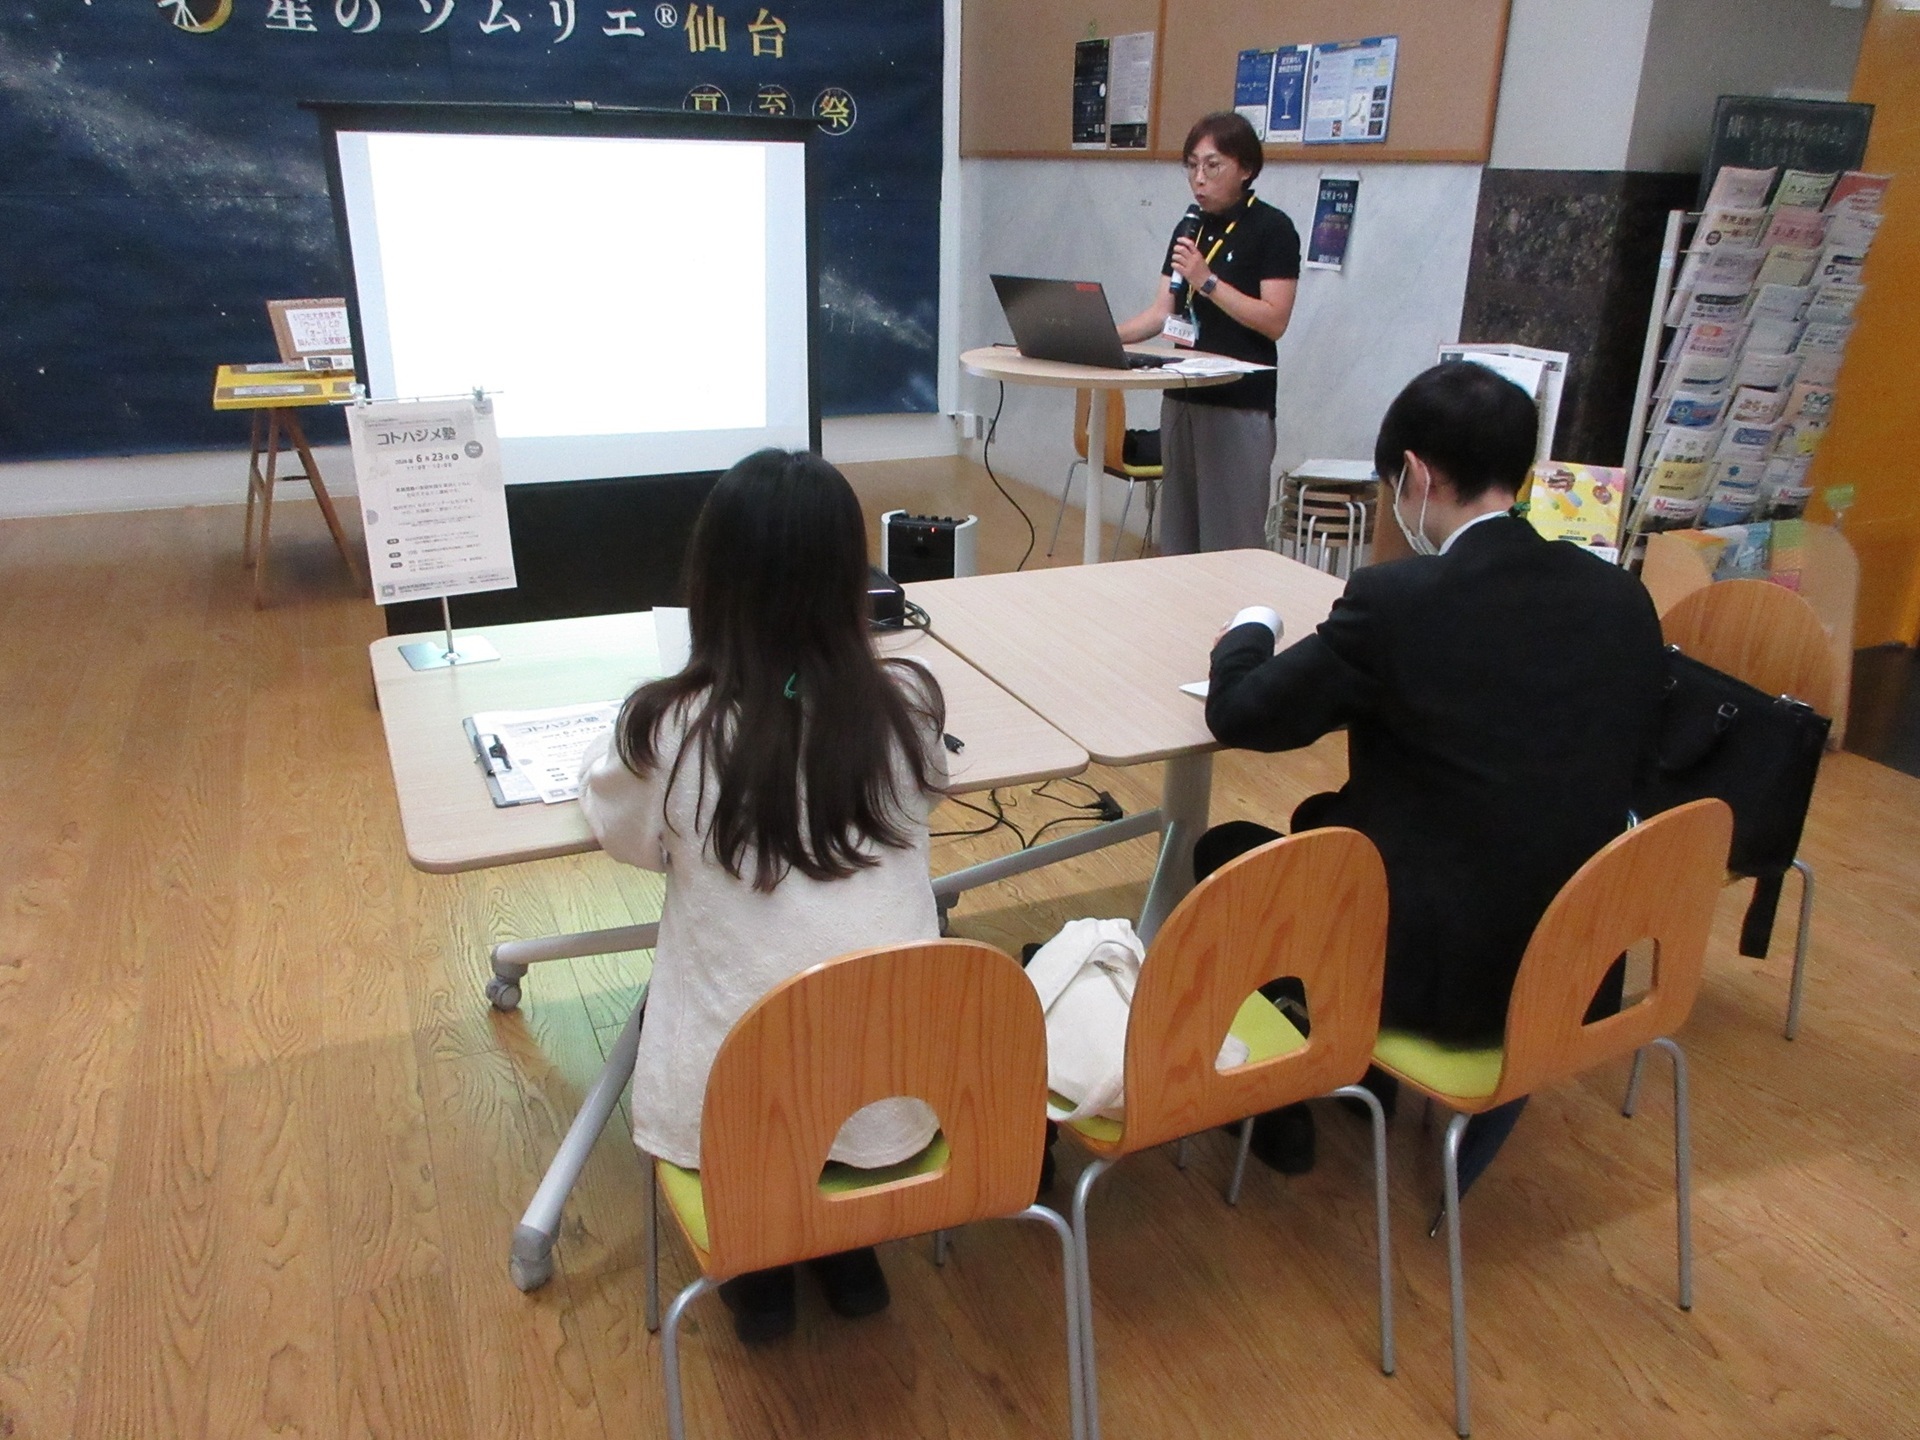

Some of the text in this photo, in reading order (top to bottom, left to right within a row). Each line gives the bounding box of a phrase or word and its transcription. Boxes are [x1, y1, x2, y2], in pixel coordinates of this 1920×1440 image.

[377, 427, 456, 445] コトハジメ塾
